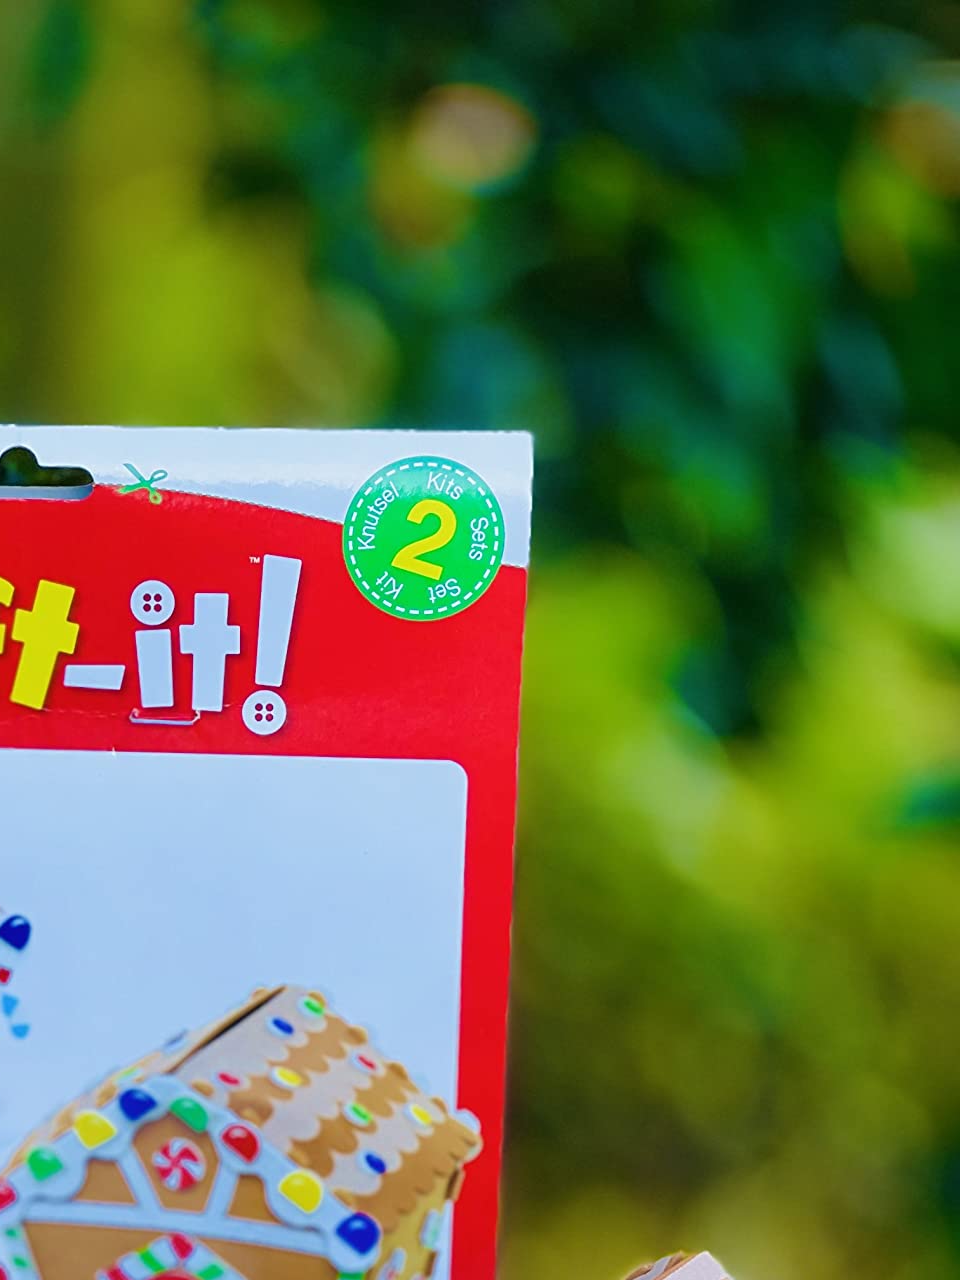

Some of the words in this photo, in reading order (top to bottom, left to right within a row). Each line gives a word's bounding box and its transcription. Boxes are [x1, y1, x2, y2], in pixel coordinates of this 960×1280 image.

[427, 471, 464, 500] Kits
[357, 481, 400, 551] Knutsel
[391, 498, 457, 581] 2
[468, 516, 489, 561] Sets
[375, 571, 404, 600] Kit
[427, 577, 462, 604] Set
